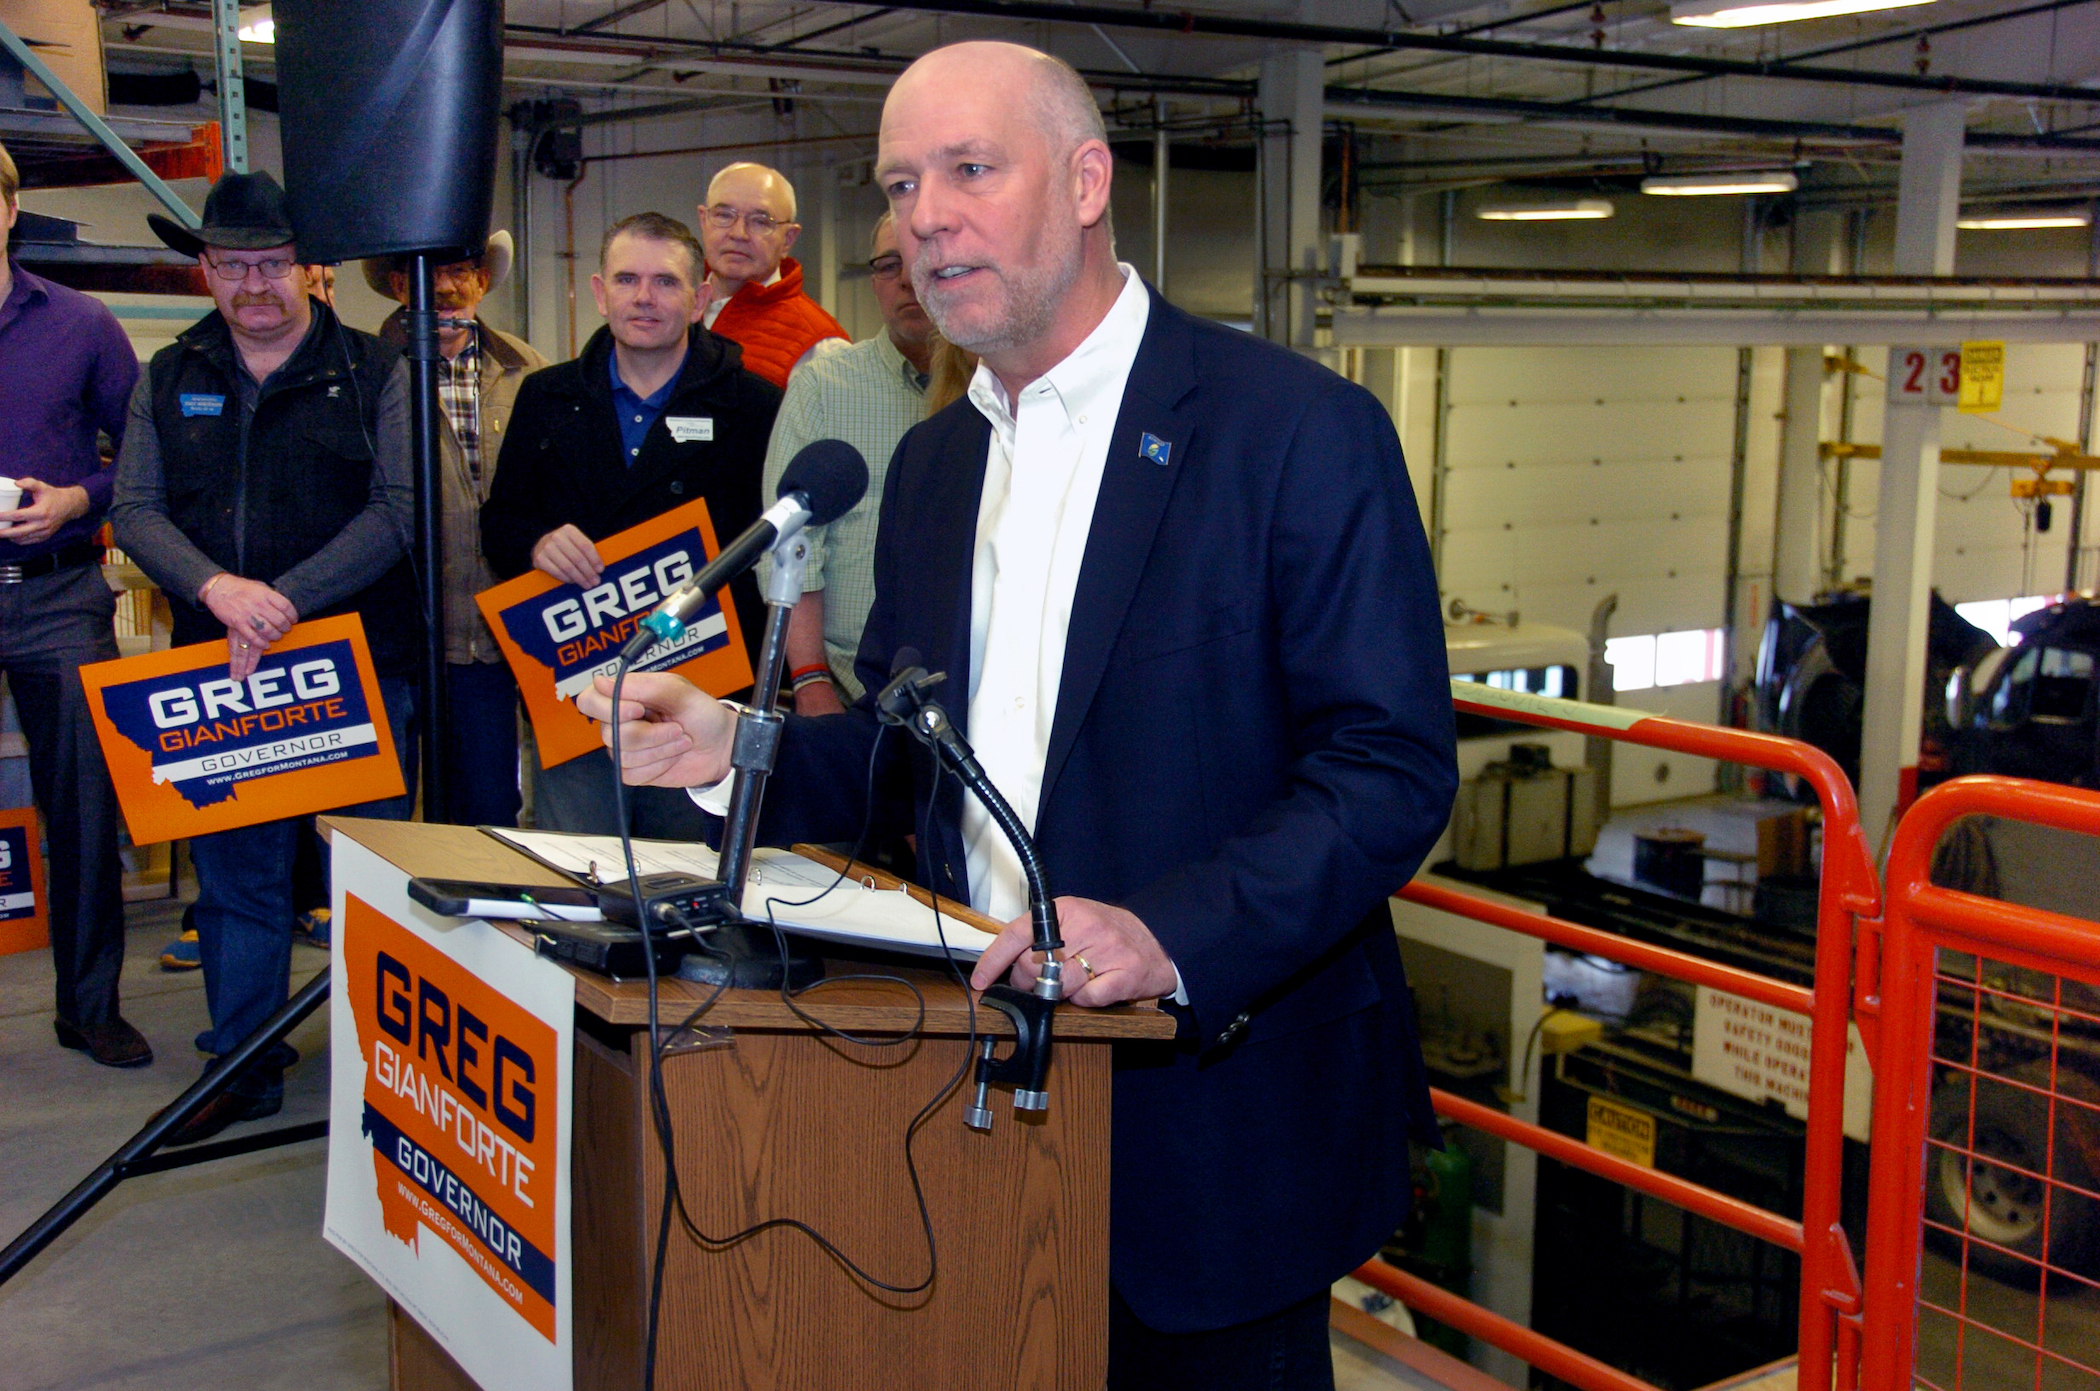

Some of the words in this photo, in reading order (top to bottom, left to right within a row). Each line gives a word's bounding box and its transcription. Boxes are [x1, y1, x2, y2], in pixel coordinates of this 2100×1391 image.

[676, 426, 710, 435] Pitman
[542, 550, 694, 643] GREG
[557, 606, 652, 667] GIANF
[148, 658, 341, 729] GREG
[158, 697, 348, 752] GIANFORTE
[201, 732, 343, 773] GOVERNOR
[1710, 994, 1774, 1026] OPERATOR
[377, 950, 535, 1144] GREG
[1723, 1041, 1760, 1064] WHILE
[1764, 1055, 1805, 1082] OPERA
[1724, 1020, 1771, 1046] SAFETY
[1775, 1038, 1809, 1060] GOGG
[1734, 1064, 1760, 1086] THIS
[1765, 1079, 1809, 1101] MACHI
[375, 1040, 535, 1208] GIANFORTE
[399, 1136, 522, 1270] GOVERNOR
